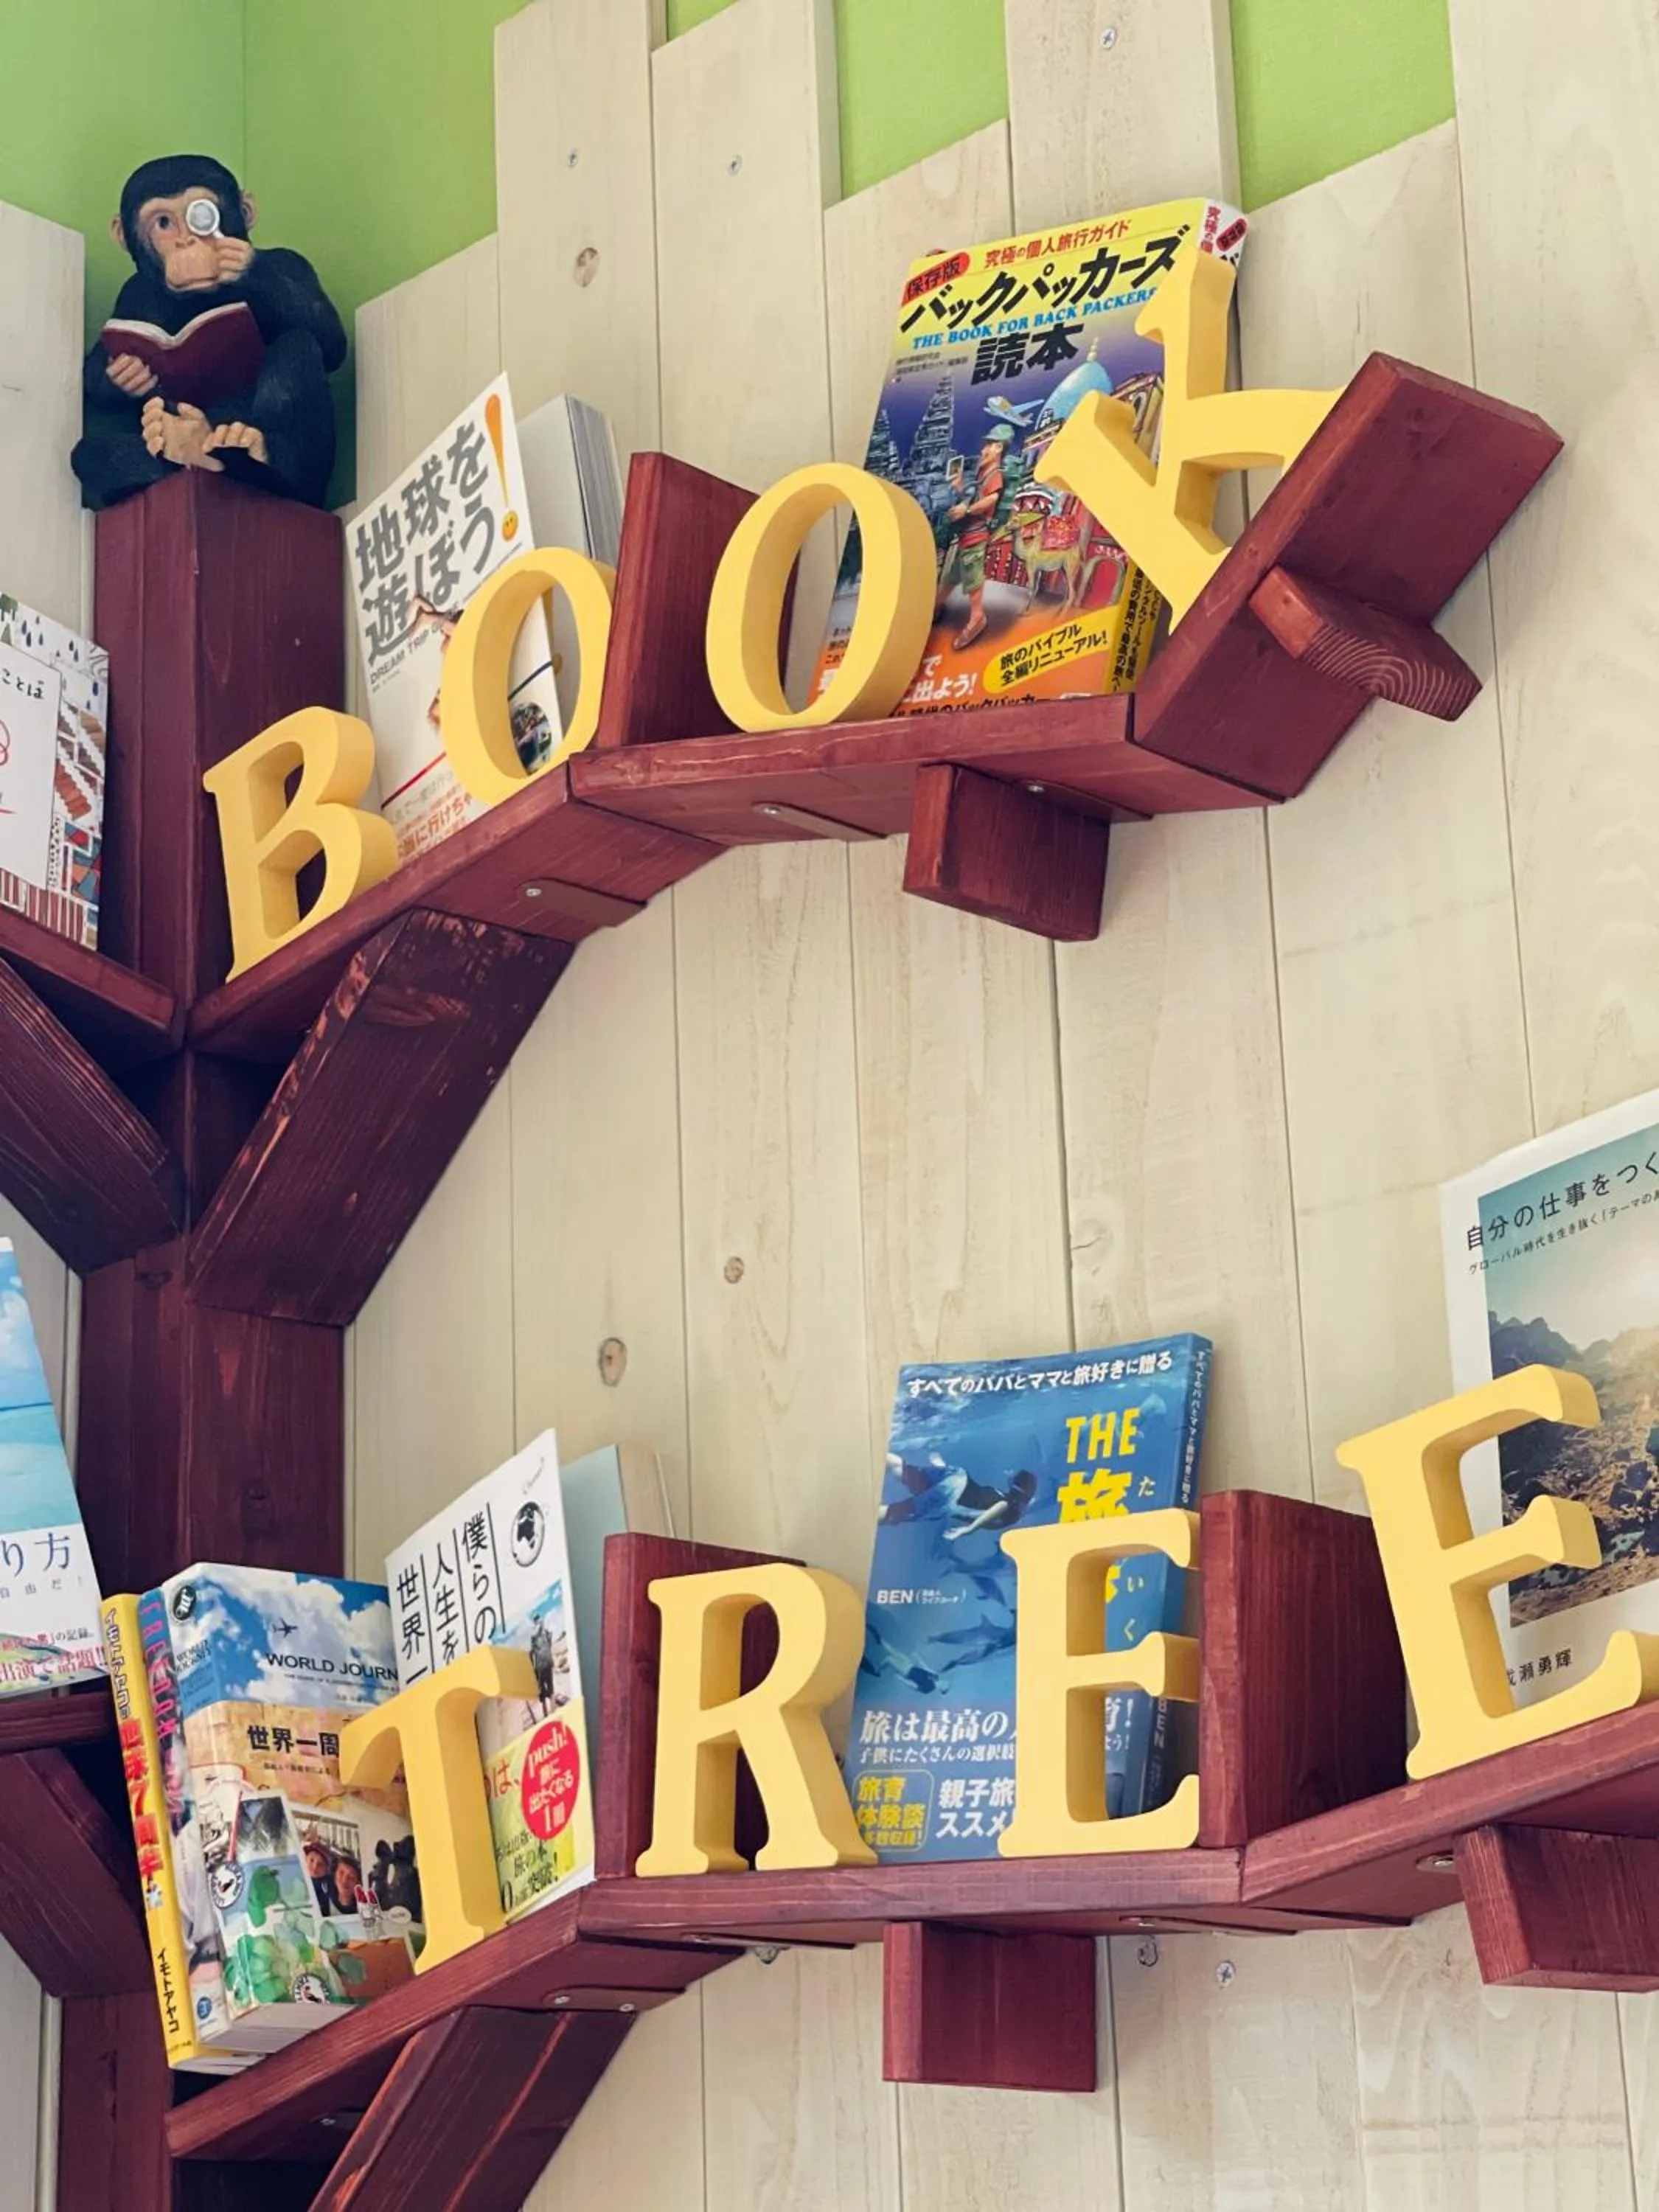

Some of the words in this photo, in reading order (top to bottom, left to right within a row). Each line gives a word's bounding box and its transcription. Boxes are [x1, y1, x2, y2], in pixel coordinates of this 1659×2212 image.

[984, 220, 1132, 268] 究極の個人旅行ガイド
[900, 224, 1191, 333] バックパッカーズ
[906, 257, 961, 300] 保存版
[914, 333, 943, 349] THE
[948, 324, 993, 344] BOOK
[998, 316, 1029, 333] FOR
[1034, 303, 1077, 325] BACK
[972, 322, 1084, 385] 読本
[355, 419, 490, 588] 地球を
[370, 650, 405, 685] DREAM
[408, 629, 428, 655] TRIP
[904, 672, 978, 703] 出よう!
[1467, 1151, 1659, 1251] 自分の仕事をつく
[907, 1351, 1173, 1399] すべてのパパとママと旅好きに贈る
[1065, 1408, 1141, 1464] THE
[431, 1541, 460, 1662] 人生を
[462, 1510, 496, 1644] 僕らの
[877, 1589, 914, 1604] BEN
[396, 1563, 428, 1686] 世界一
[265, 1652, 335, 1673] WORLD
[339, 1663, 398, 1681] JOURN
[247, 1725, 340, 1758] 世界一周
[528, 1722, 568, 1778] push!
